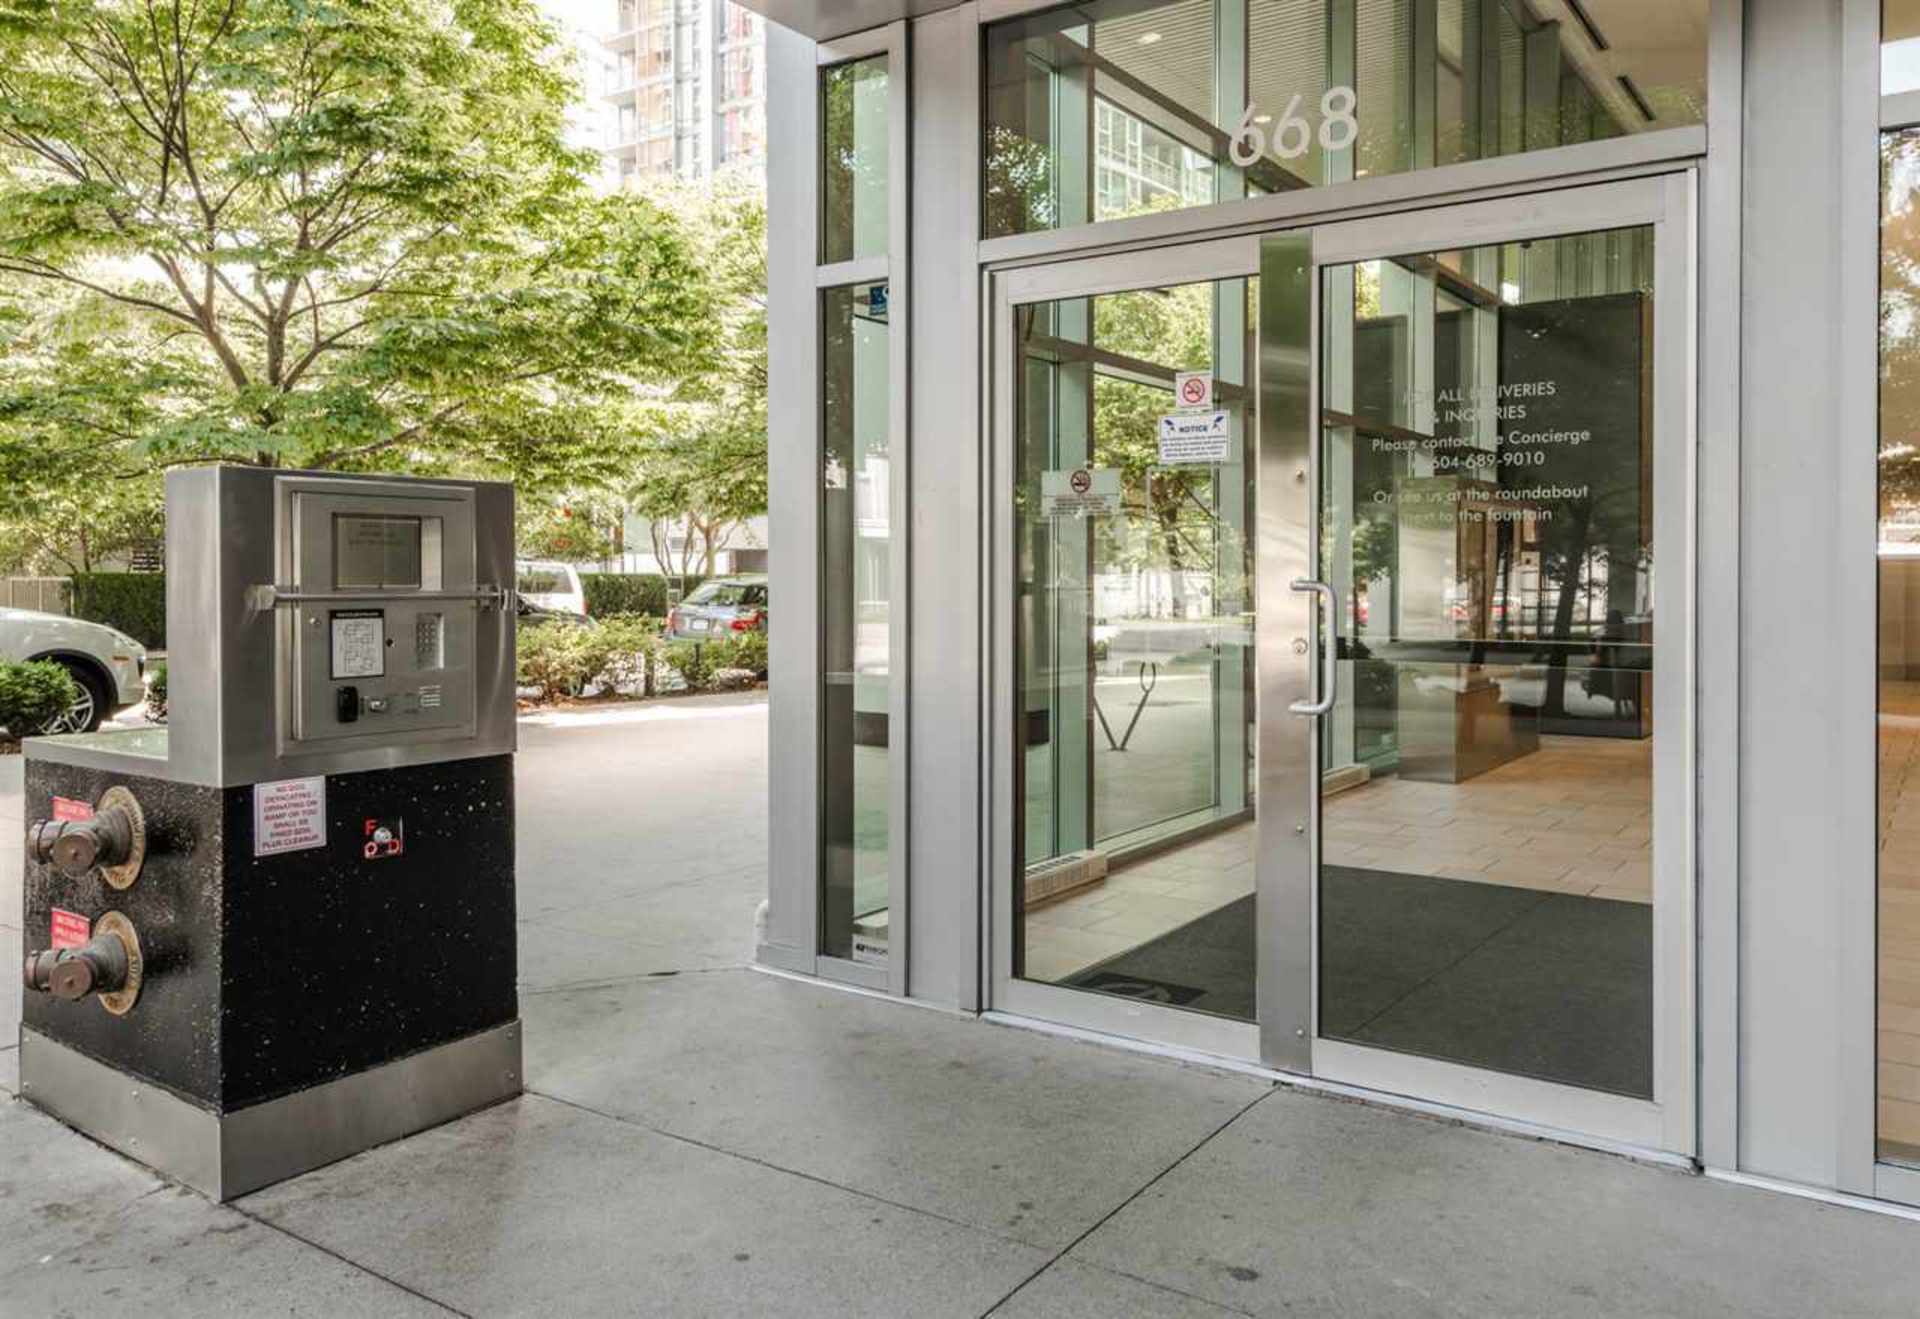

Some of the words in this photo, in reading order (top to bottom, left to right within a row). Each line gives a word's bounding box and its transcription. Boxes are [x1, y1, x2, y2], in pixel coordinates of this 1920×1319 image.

[1229, 86, 1358, 168] 668
[1438, 387, 1464, 403] ALL
[1469, 381, 1557, 401] IVERIES
[1445, 404, 1527, 423] INQRIES
[1372, 437, 1417, 453] Please
[1509, 428, 1590, 445] Concierge
[1432, 450, 1545, 470] 604-689-9010
[1373, 490, 1393, 504] Or
[1465, 487, 1489, 501] the
[1495, 484, 1588, 500] roundabout
[1459, 508, 1483, 522] the
[1486, 505, 1552, 522] fountain
